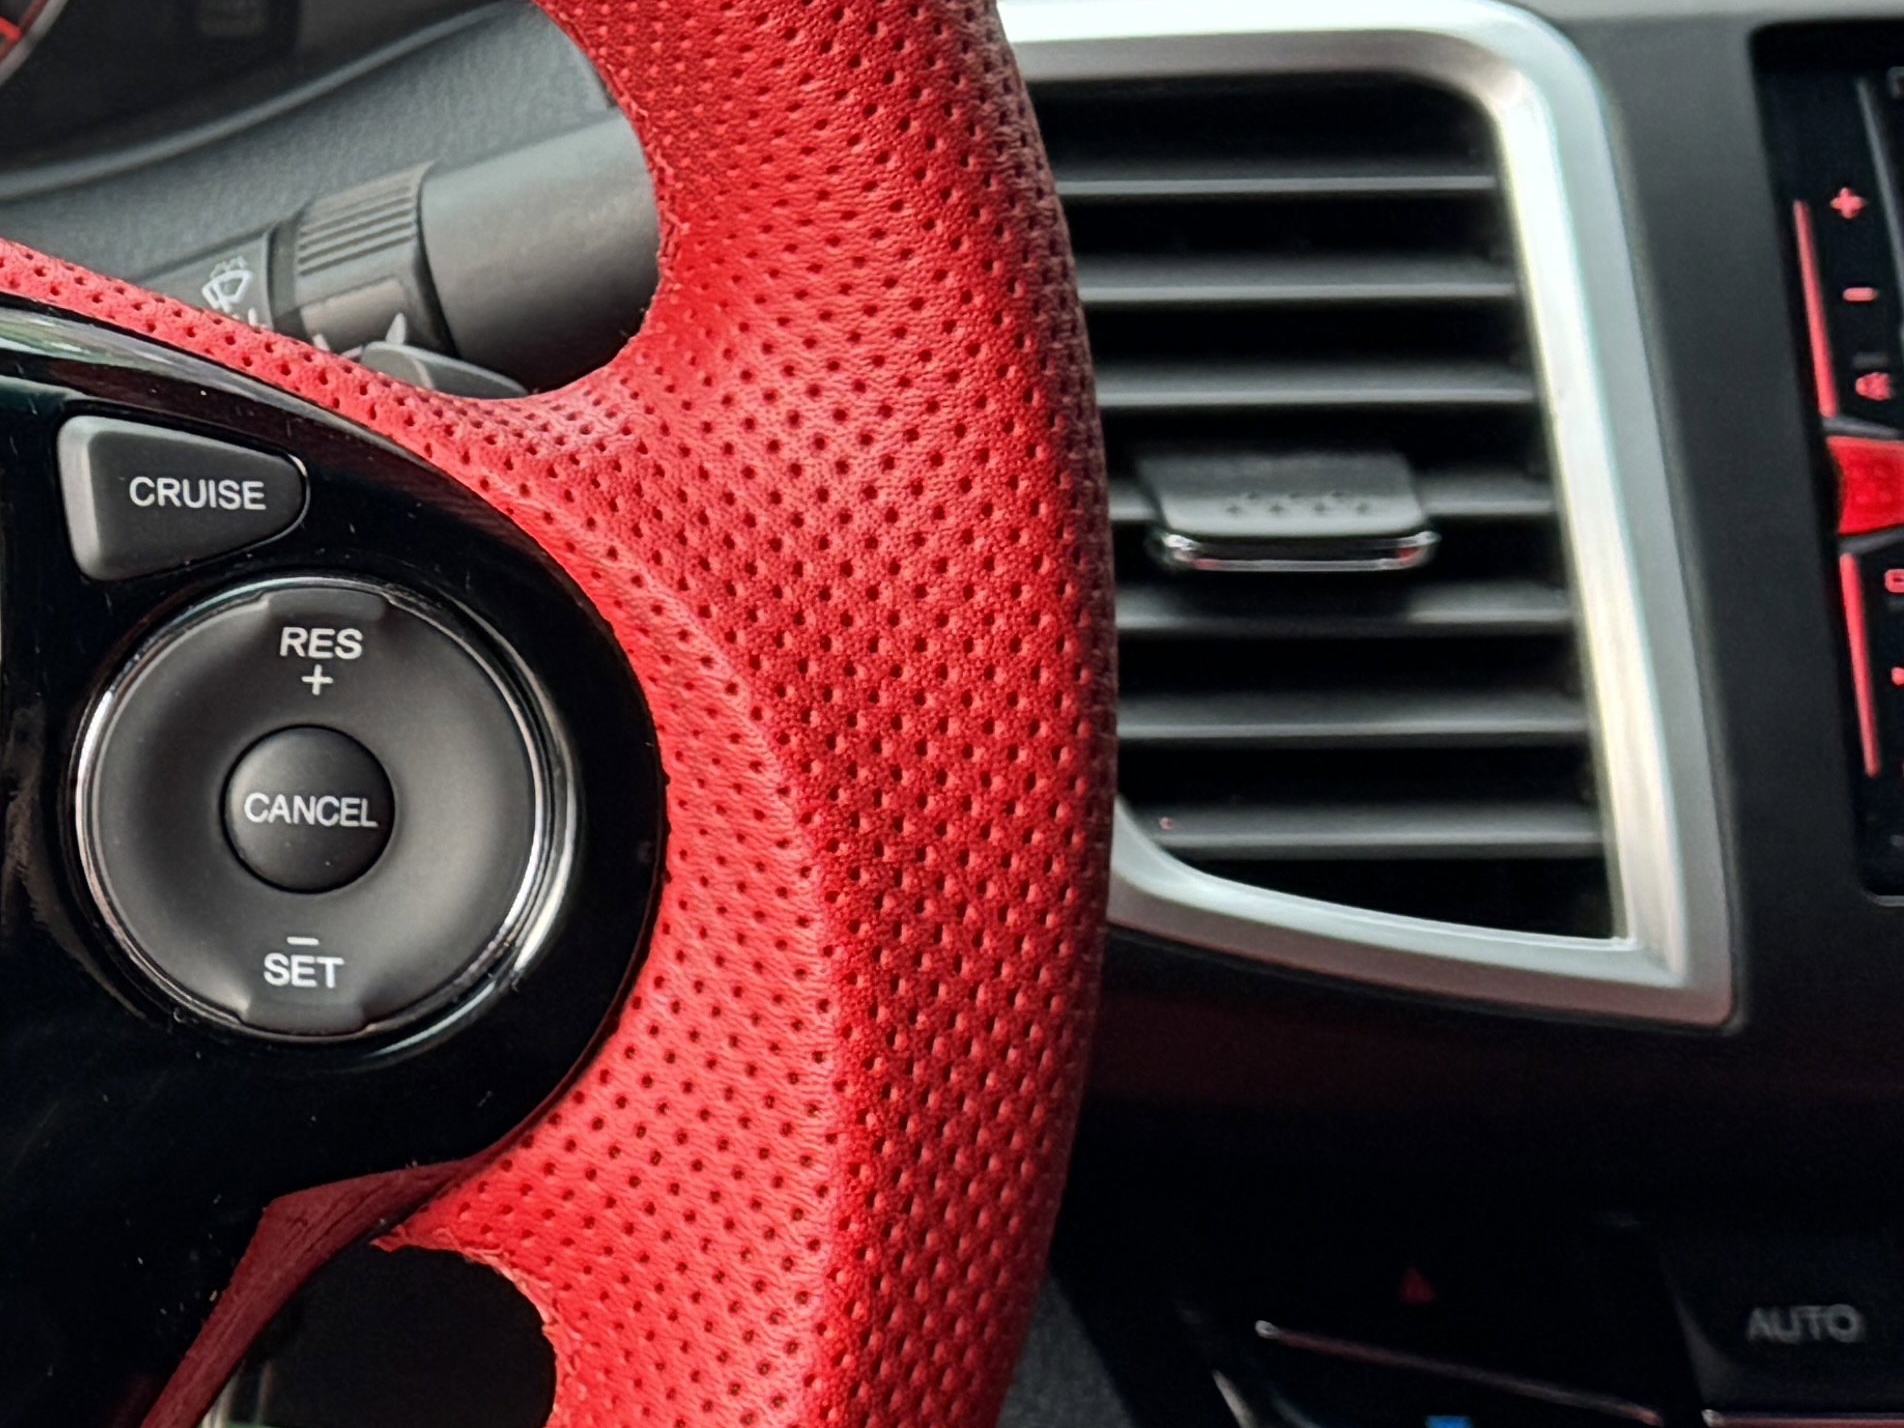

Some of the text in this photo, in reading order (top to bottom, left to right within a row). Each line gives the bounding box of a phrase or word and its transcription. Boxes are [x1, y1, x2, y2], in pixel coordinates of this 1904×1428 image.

[128, 476, 267, 511] CRUISE
[279, 626, 364, 660] RES
[243, 791, 379, 829] CANCEL
[263, 952, 345, 989] SET
[1746, 1303, 1864, 1343] AUTO
